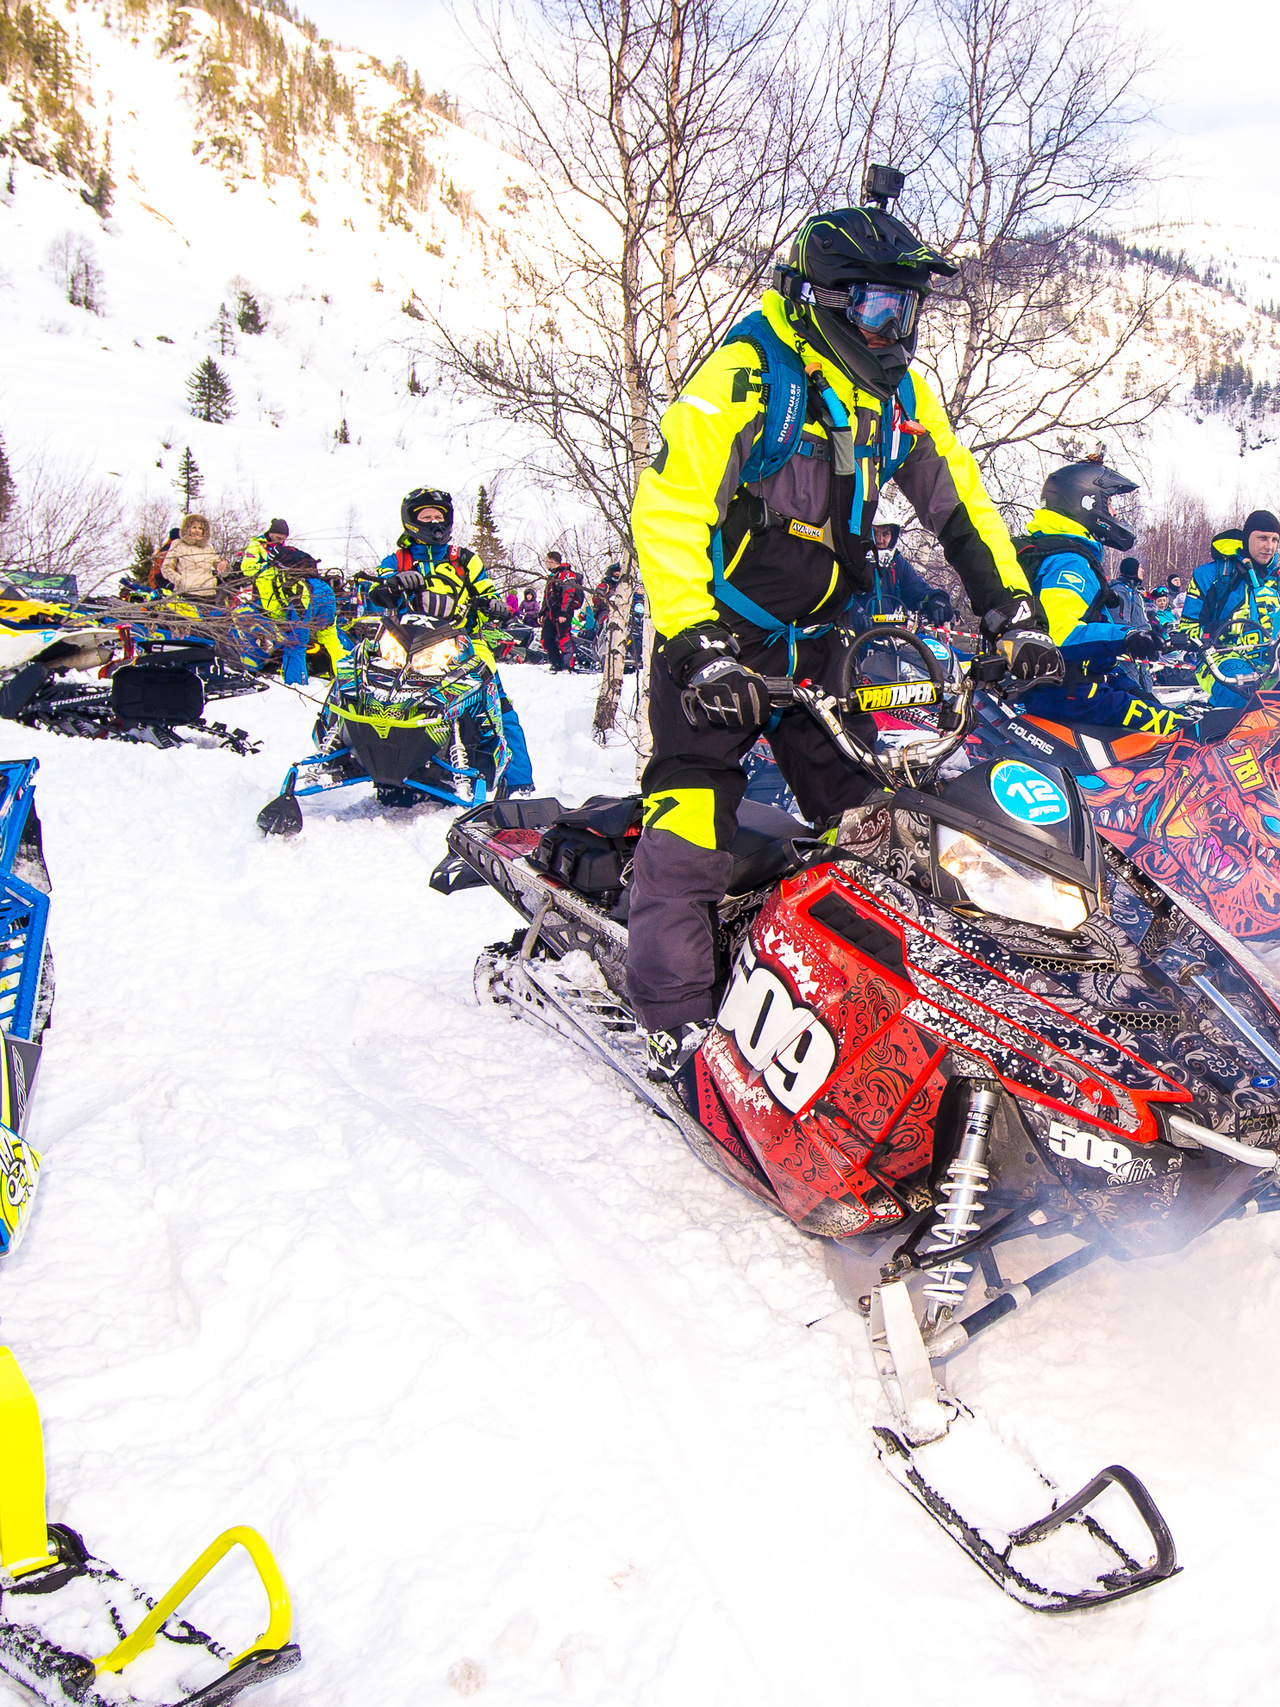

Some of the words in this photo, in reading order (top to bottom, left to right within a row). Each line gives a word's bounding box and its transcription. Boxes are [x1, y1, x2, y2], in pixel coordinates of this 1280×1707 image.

[862, 683, 934, 709] PROTAPER
[1007, 721, 1055, 755] POLARIS
[1006, 780, 1060, 804] 12
[717, 936, 836, 1114] 509
[1049, 1120, 1134, 1177] 509
